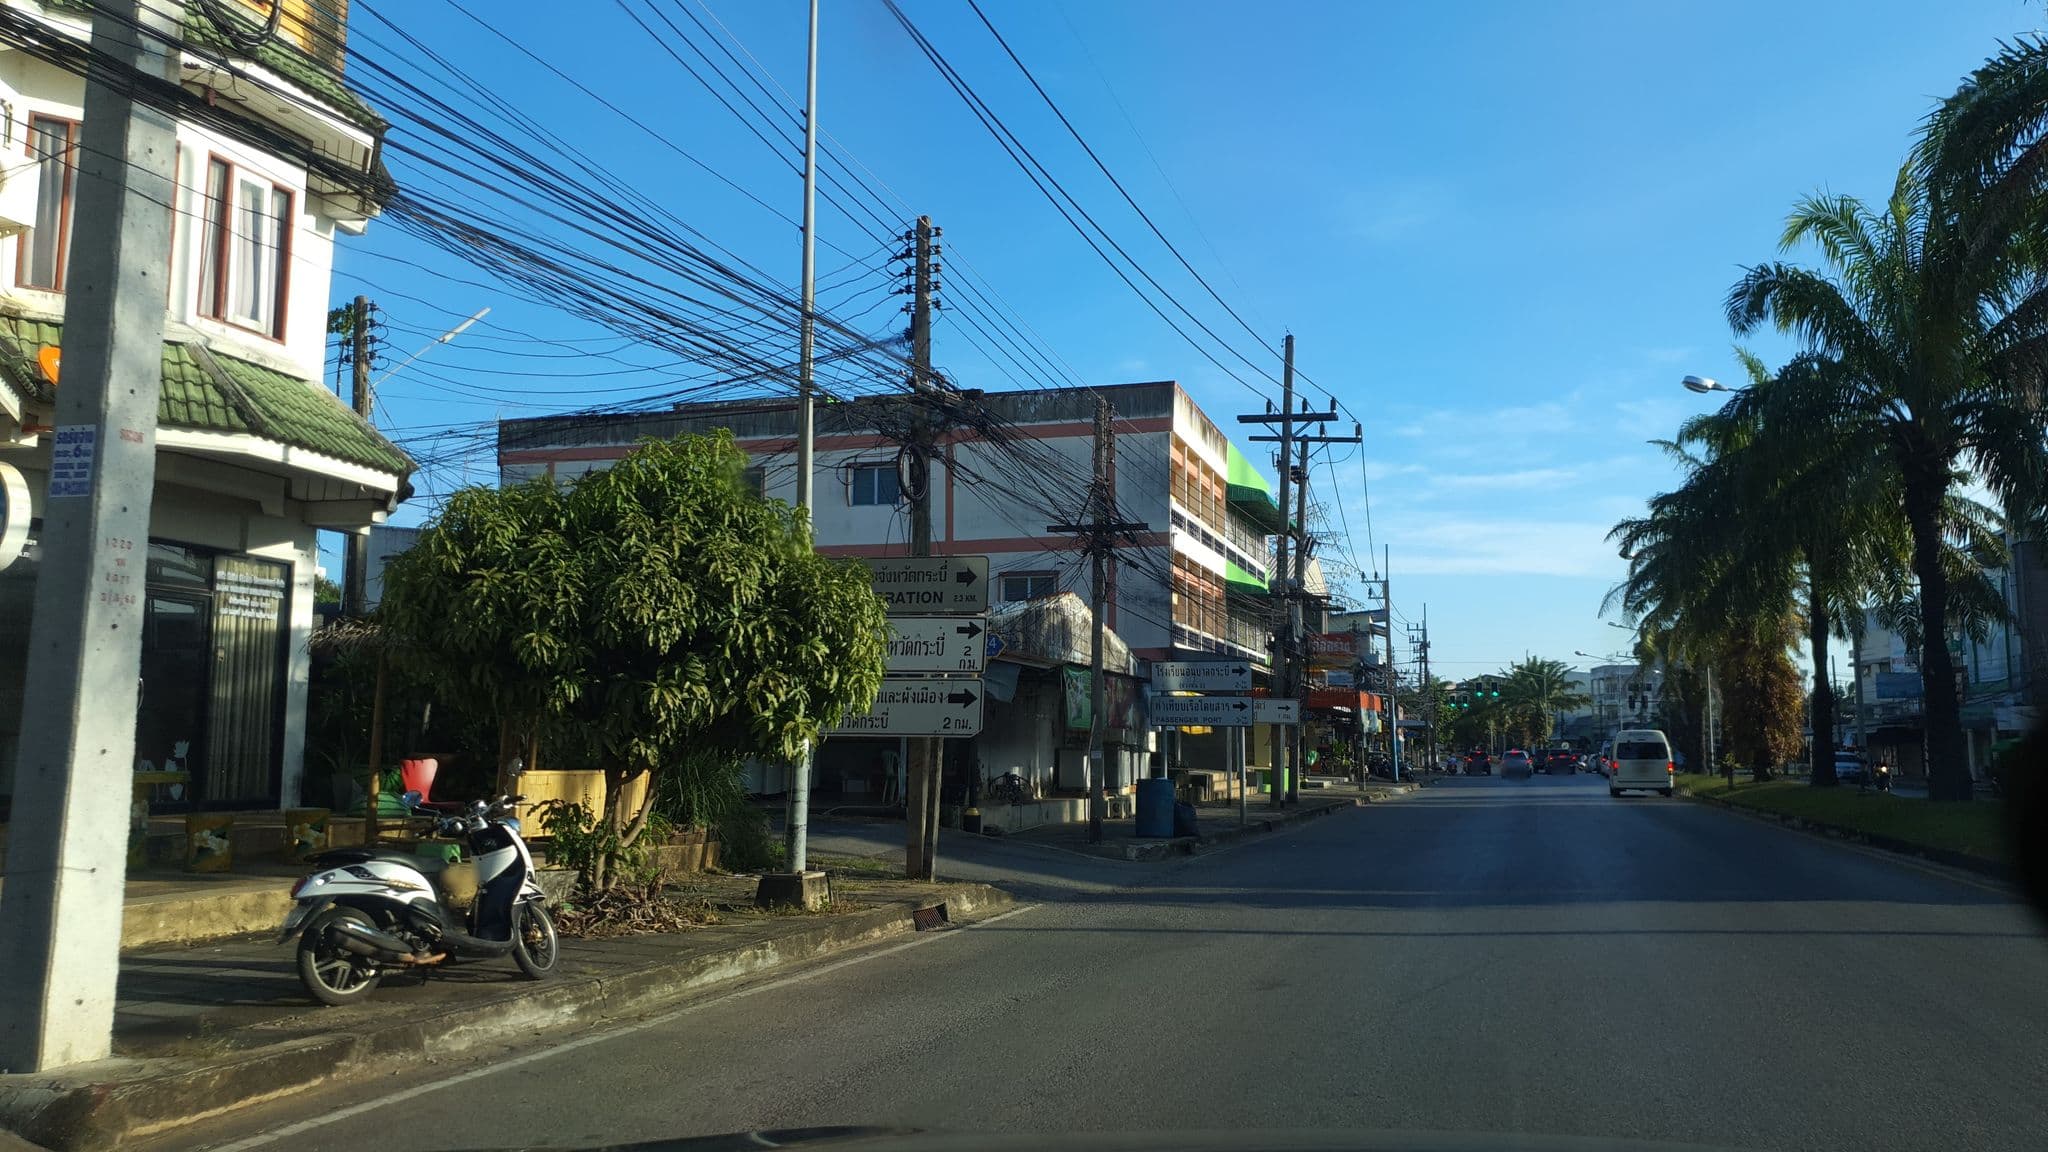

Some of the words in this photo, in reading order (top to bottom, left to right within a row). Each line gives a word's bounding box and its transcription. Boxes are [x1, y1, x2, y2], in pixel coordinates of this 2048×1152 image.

[877, 591, 944, 604] RATION
[963, 646, 971, 656] 2
[959, 658, 978, 670] กม.
[943, 718, 951, 729] 2
[954, 718, 972, 730] กม.
[1155, 716, 1199, 724] PASSENGER
[1203, 716, 1223, 724] PORT
